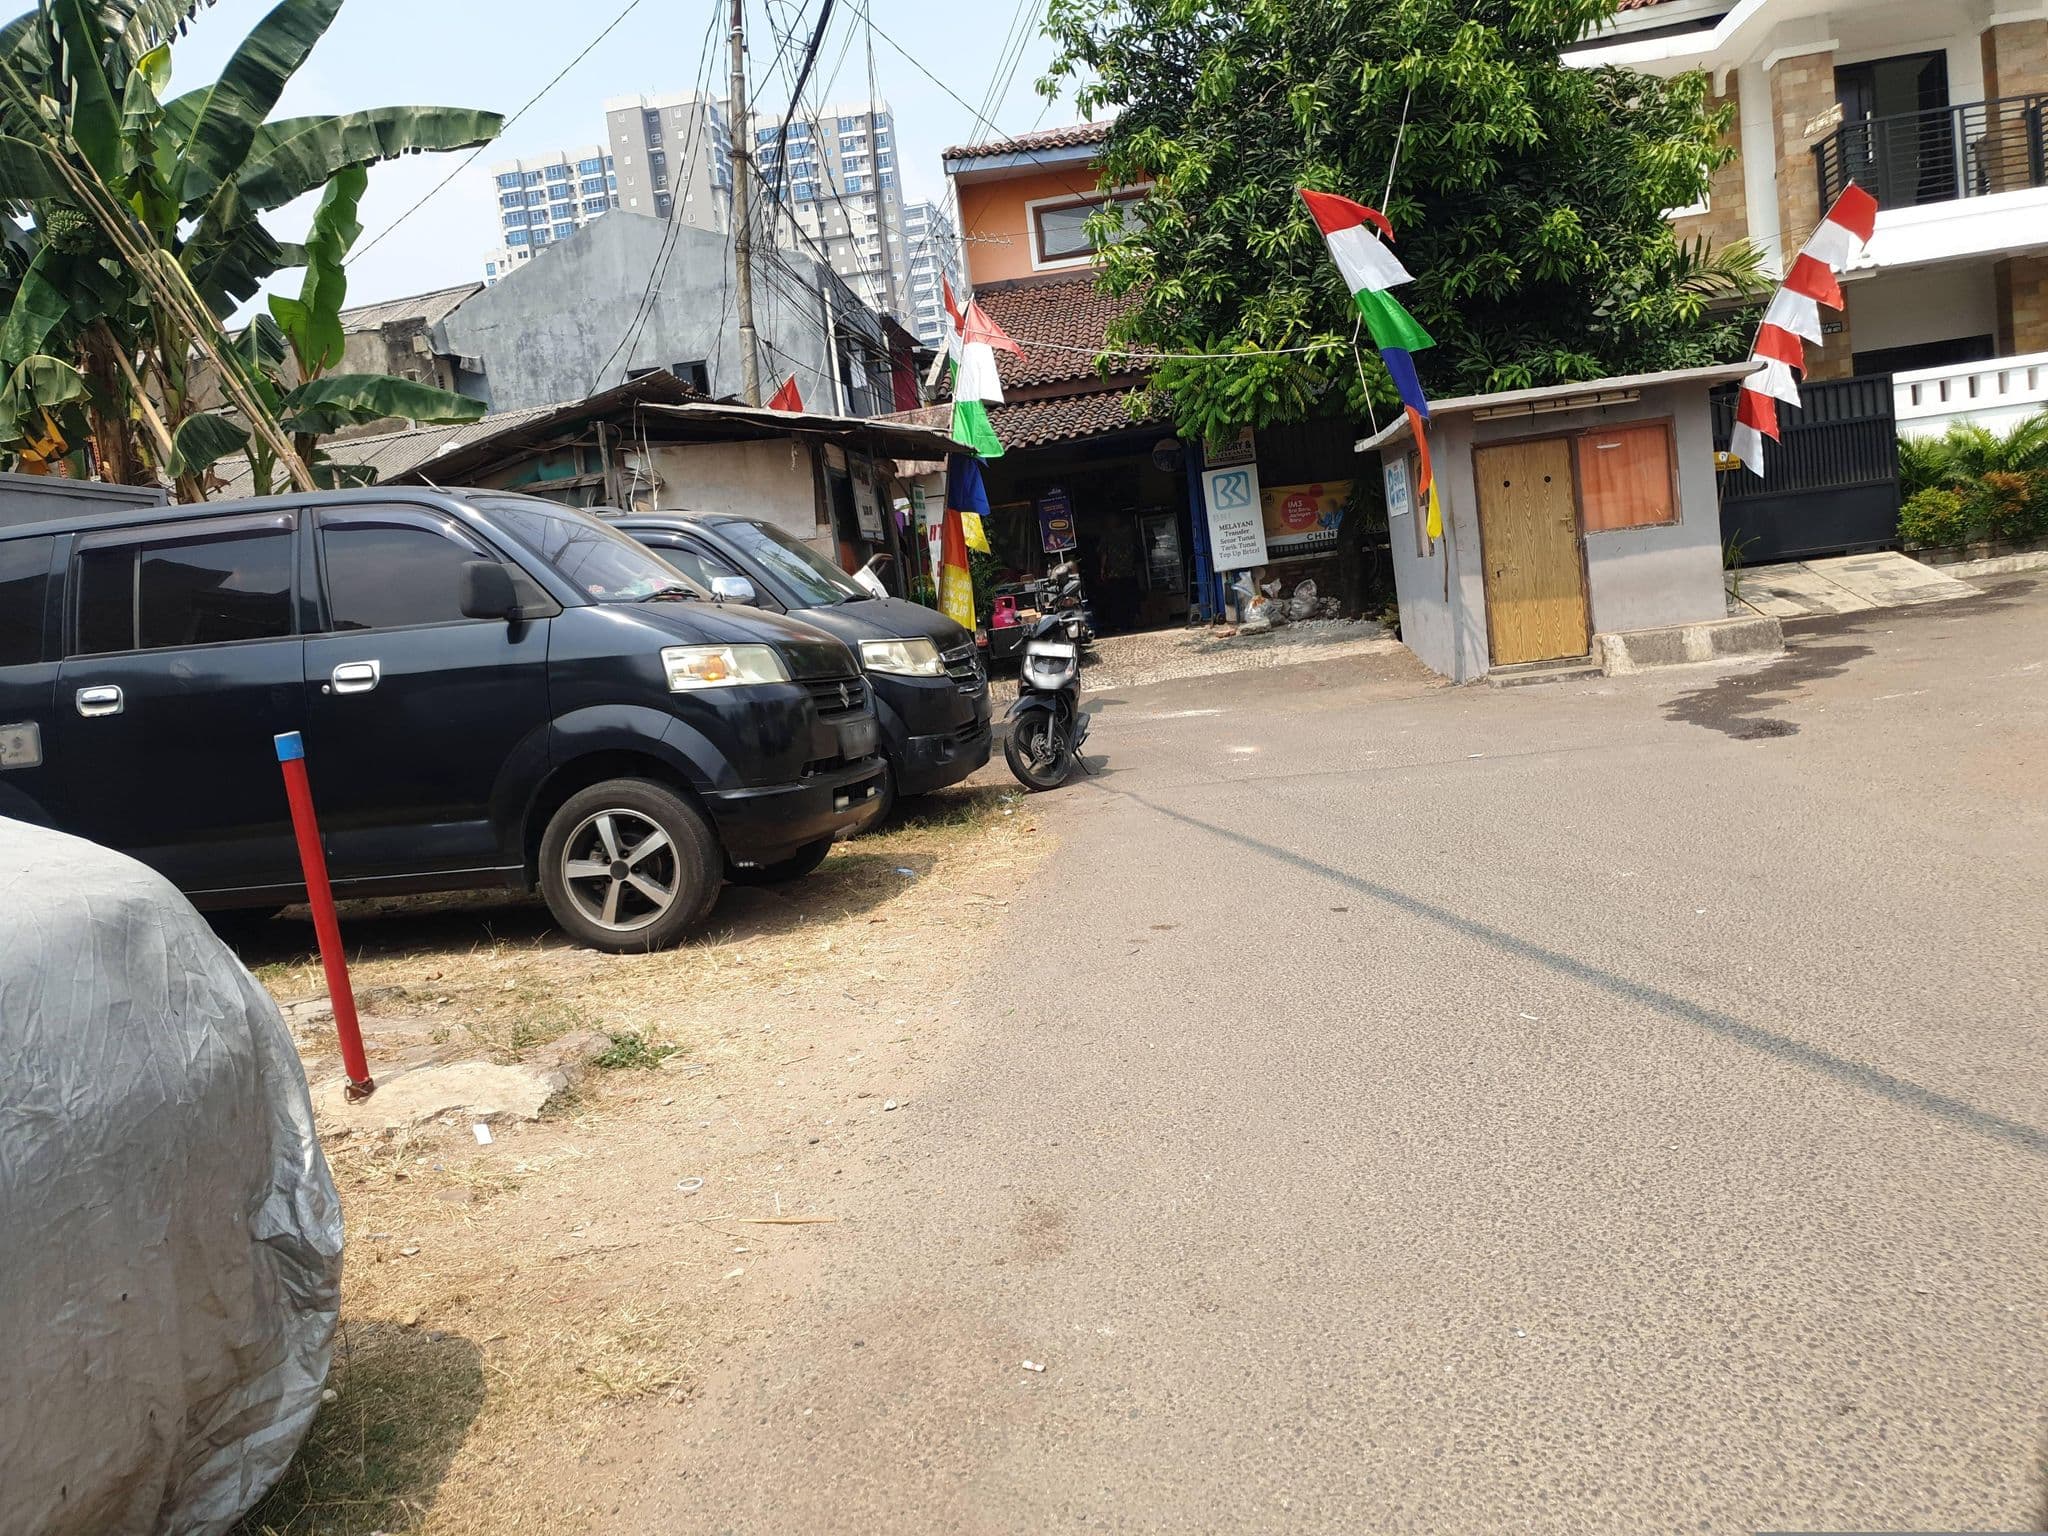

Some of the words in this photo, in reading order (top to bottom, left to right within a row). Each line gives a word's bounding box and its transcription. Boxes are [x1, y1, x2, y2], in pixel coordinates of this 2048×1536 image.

[1287, 500, 1303, 508] IM3
[1219, 520, 1254, 530] MELAYANI
[1224, 528, 1250, 537] Transfer
[1238, 534, 1256, 542] Tunai
[1219, 551, 1231, 559] Top
[1232, 549, 1241, 557] Up
